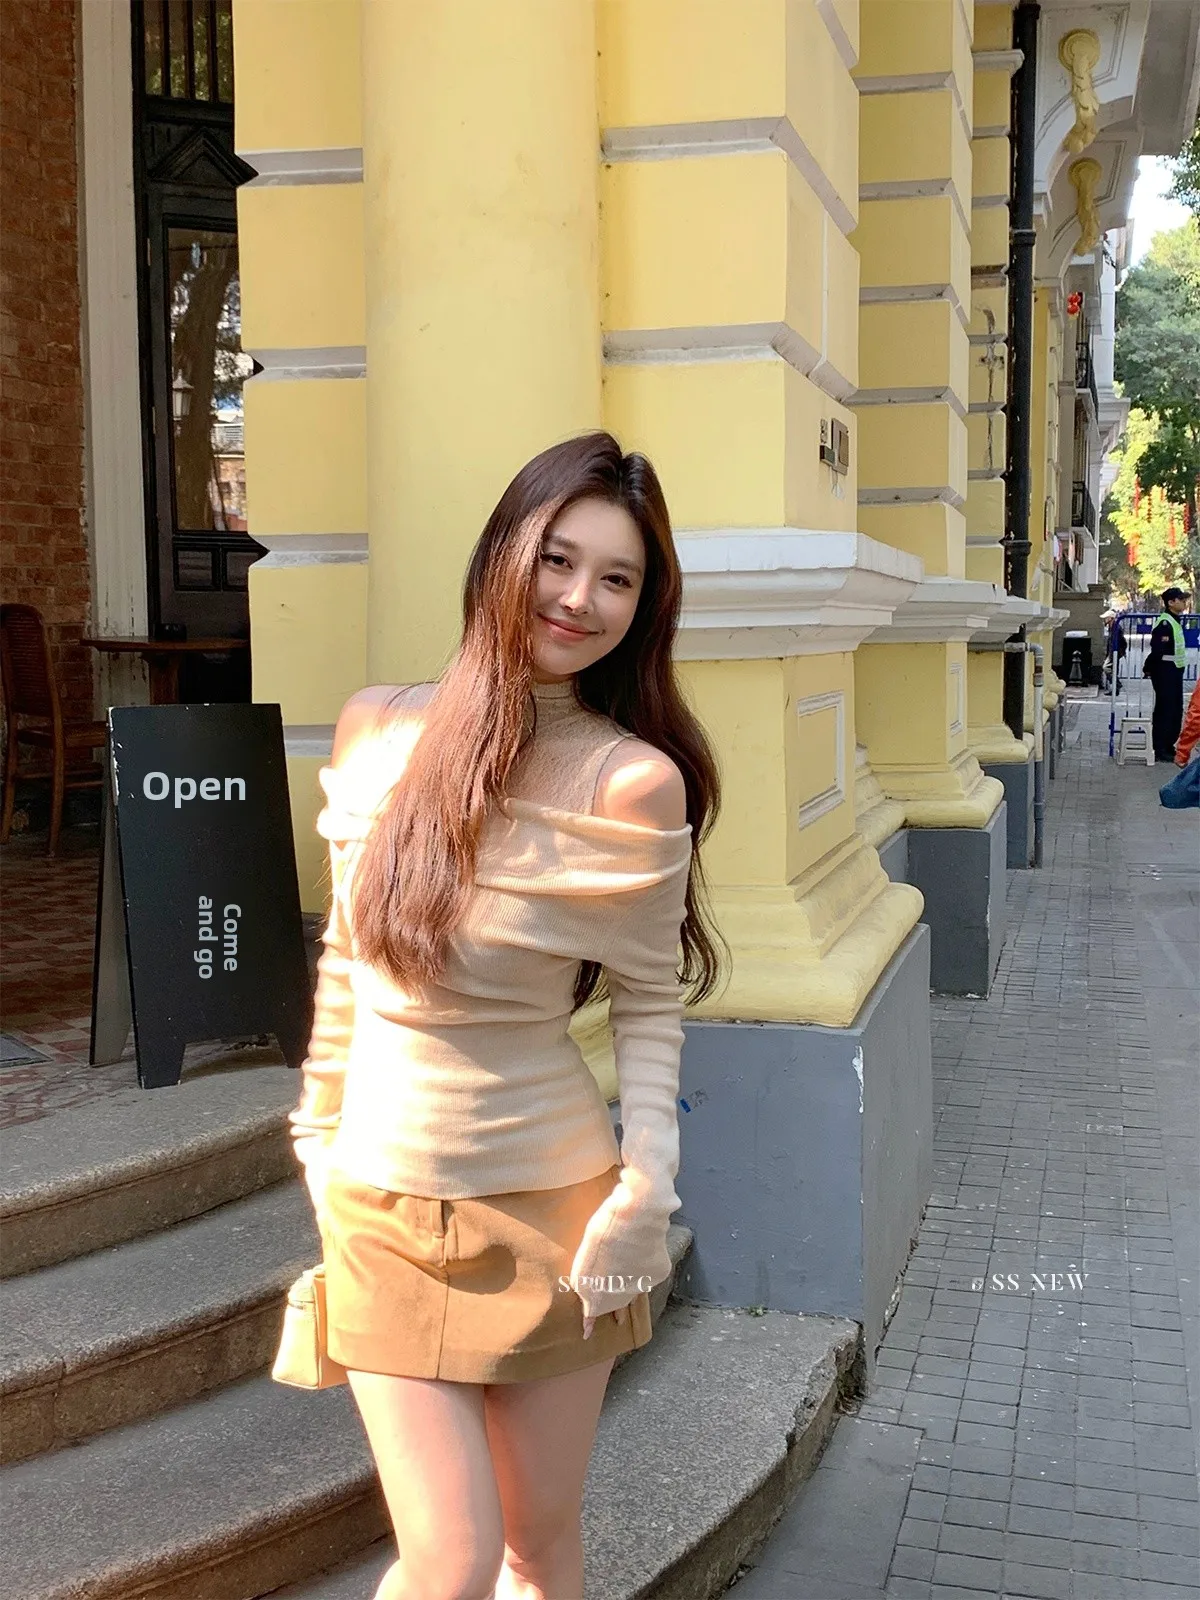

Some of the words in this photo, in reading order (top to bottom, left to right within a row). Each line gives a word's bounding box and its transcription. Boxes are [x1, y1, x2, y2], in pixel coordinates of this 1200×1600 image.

[142, 771, 246, 809] Open
[198, 895, 219, 941] and
[223, 903, 242, 972] Come
[193, 948, 213, 979] go
